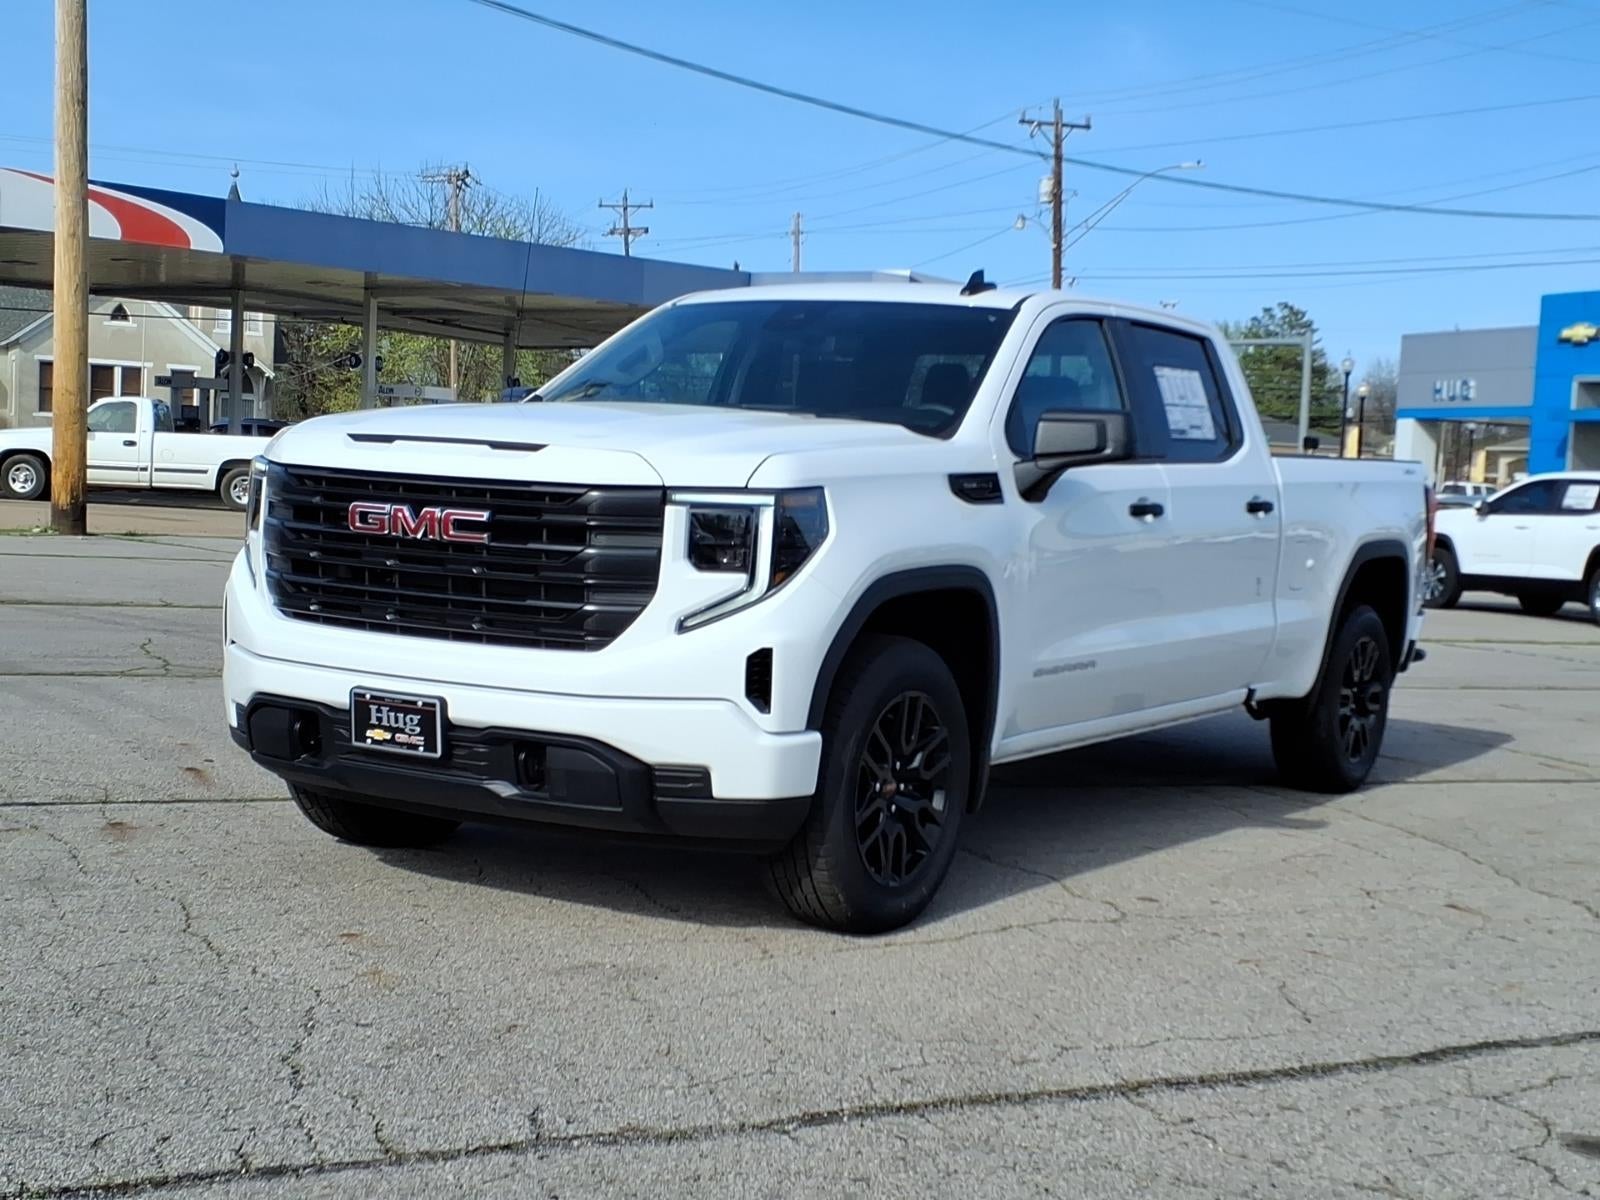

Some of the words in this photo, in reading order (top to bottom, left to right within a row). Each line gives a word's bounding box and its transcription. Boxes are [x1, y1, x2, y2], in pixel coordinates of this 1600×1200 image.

[1432, 379, 1477, 402] HUG
[348, 501, 491, 544] GMC
[369, 704, 421, 734] Hug
